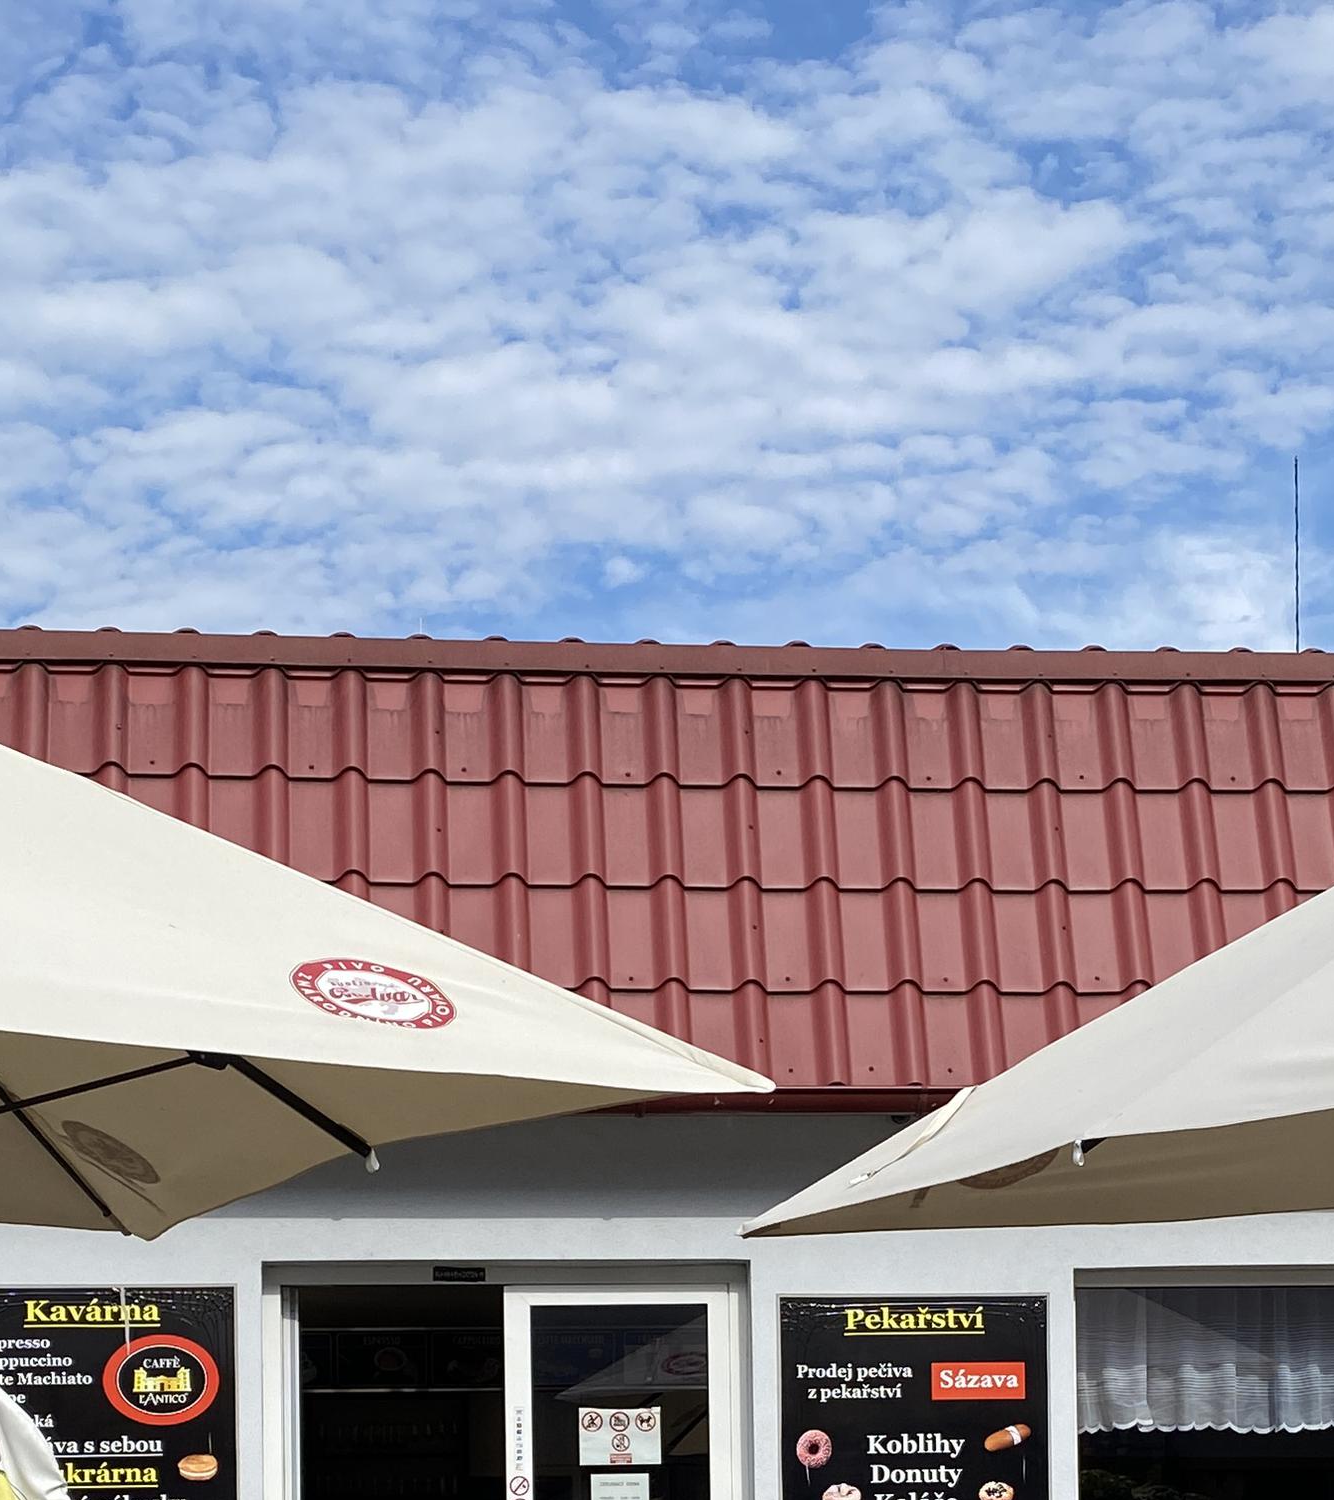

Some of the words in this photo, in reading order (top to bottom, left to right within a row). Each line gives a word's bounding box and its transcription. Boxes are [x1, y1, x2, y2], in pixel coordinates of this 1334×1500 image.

[24, 1298, 160, 1322] Kavárna
[844, 1306, 985, 1330] Pekařství
[143, 1355, 181, 1369] CAFFÈ
[796, 1363, 853, 1381] Prodej
[857, 1363, 913, 1381] pečiva
[17, 1372, 93, 1386] Machiato
[939, 1370, 1018, 1390] Sázava
[808, 1386, 818, 1399] z
[820, 1383, 902, 1402] pekařství
[84, 1440, 95, 1453] s
[99, 1435, 163, 1453] sebou
[867, 1433, 965, 1458] Koblihy
[61, 1462, 158, 1483] krárna
[870, 1464, 963, 1487] Donuty
